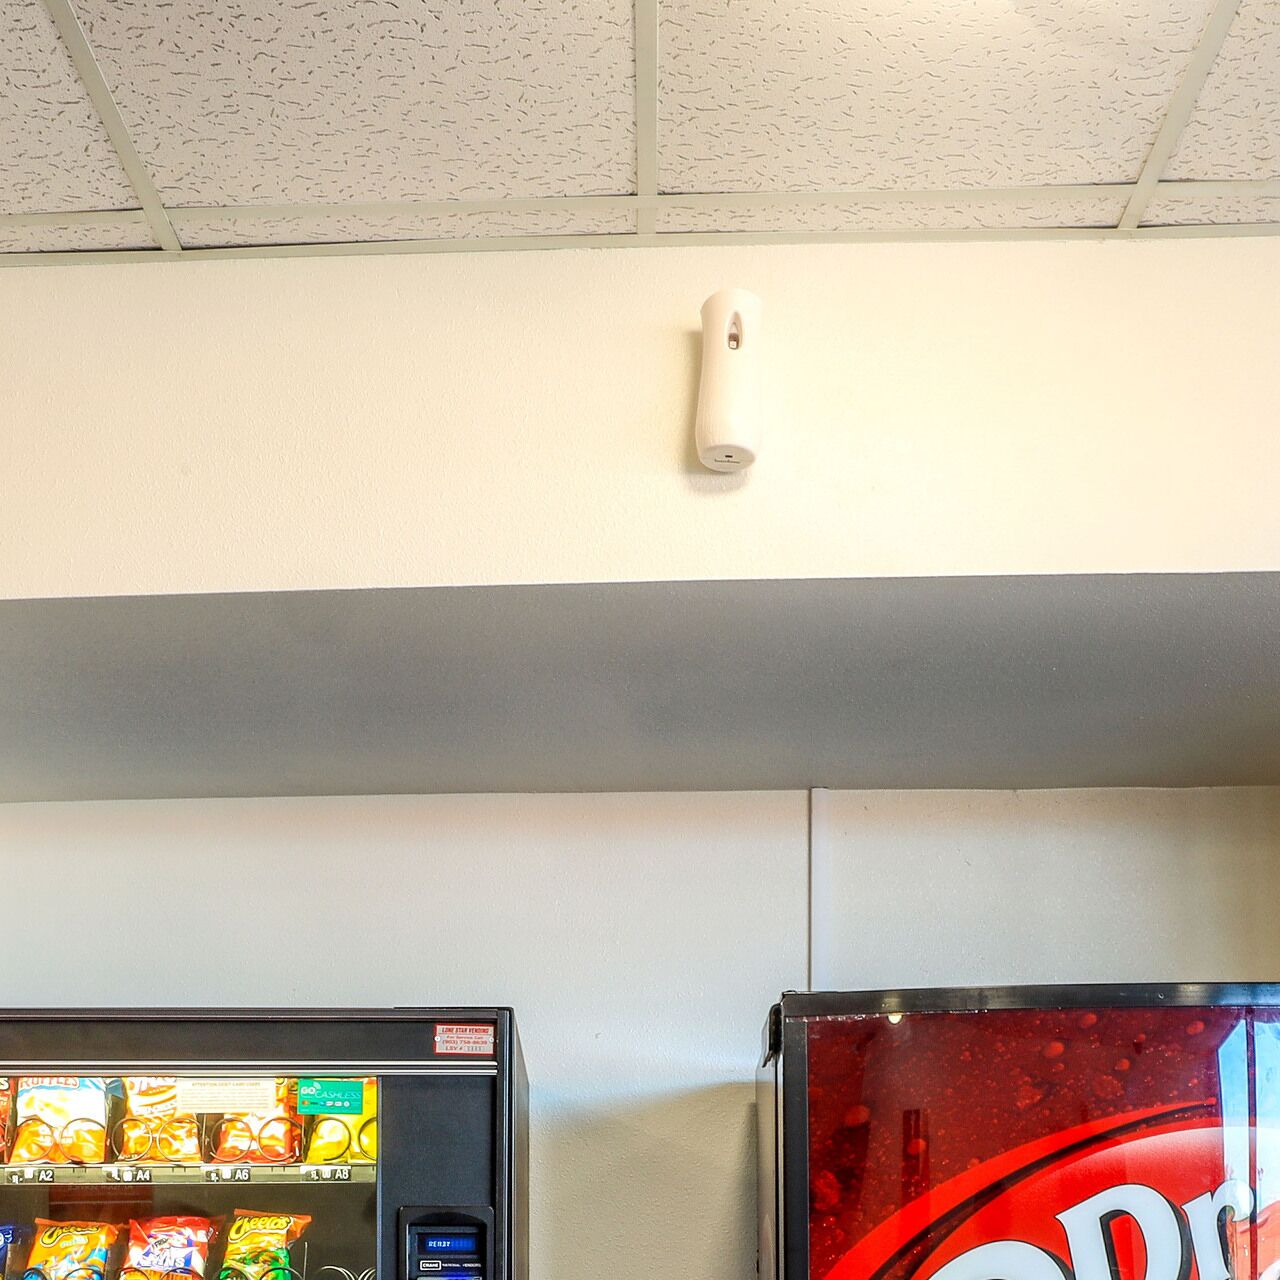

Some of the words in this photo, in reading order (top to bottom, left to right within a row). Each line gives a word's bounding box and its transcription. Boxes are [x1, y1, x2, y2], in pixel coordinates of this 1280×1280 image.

[301, 1086, 317, 1095] GO
[315, 1090, 362, 1099] CASHLESS
[39, 1170, 53, 1182] A2
[137, 1169, 150, 1181] A4
[235, 1169, 249, 1181] A6
[335, 1168, 349, 1180] A8
